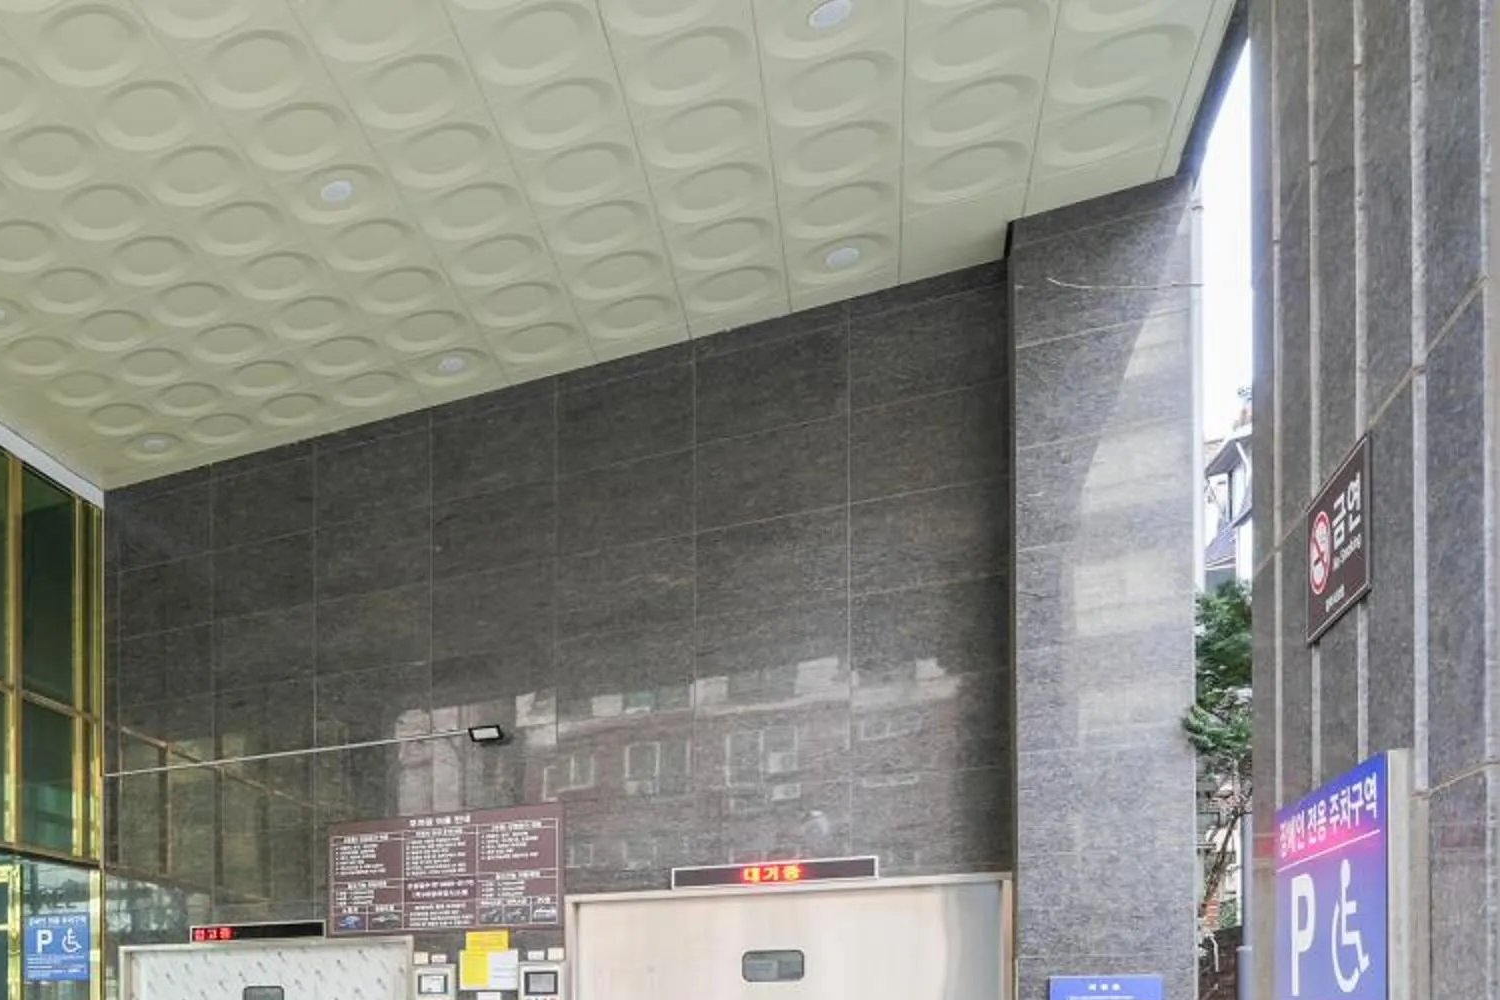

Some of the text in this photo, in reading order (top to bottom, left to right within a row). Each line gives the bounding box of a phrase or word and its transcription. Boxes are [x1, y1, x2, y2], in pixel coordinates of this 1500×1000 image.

[1332, 472, 1362, 551] 금연
[1280, 771, 1377, 859] 장애인 전용 주차구역
[37, 929, 53, 953] P
[1290, 872, 1315, 997] P
